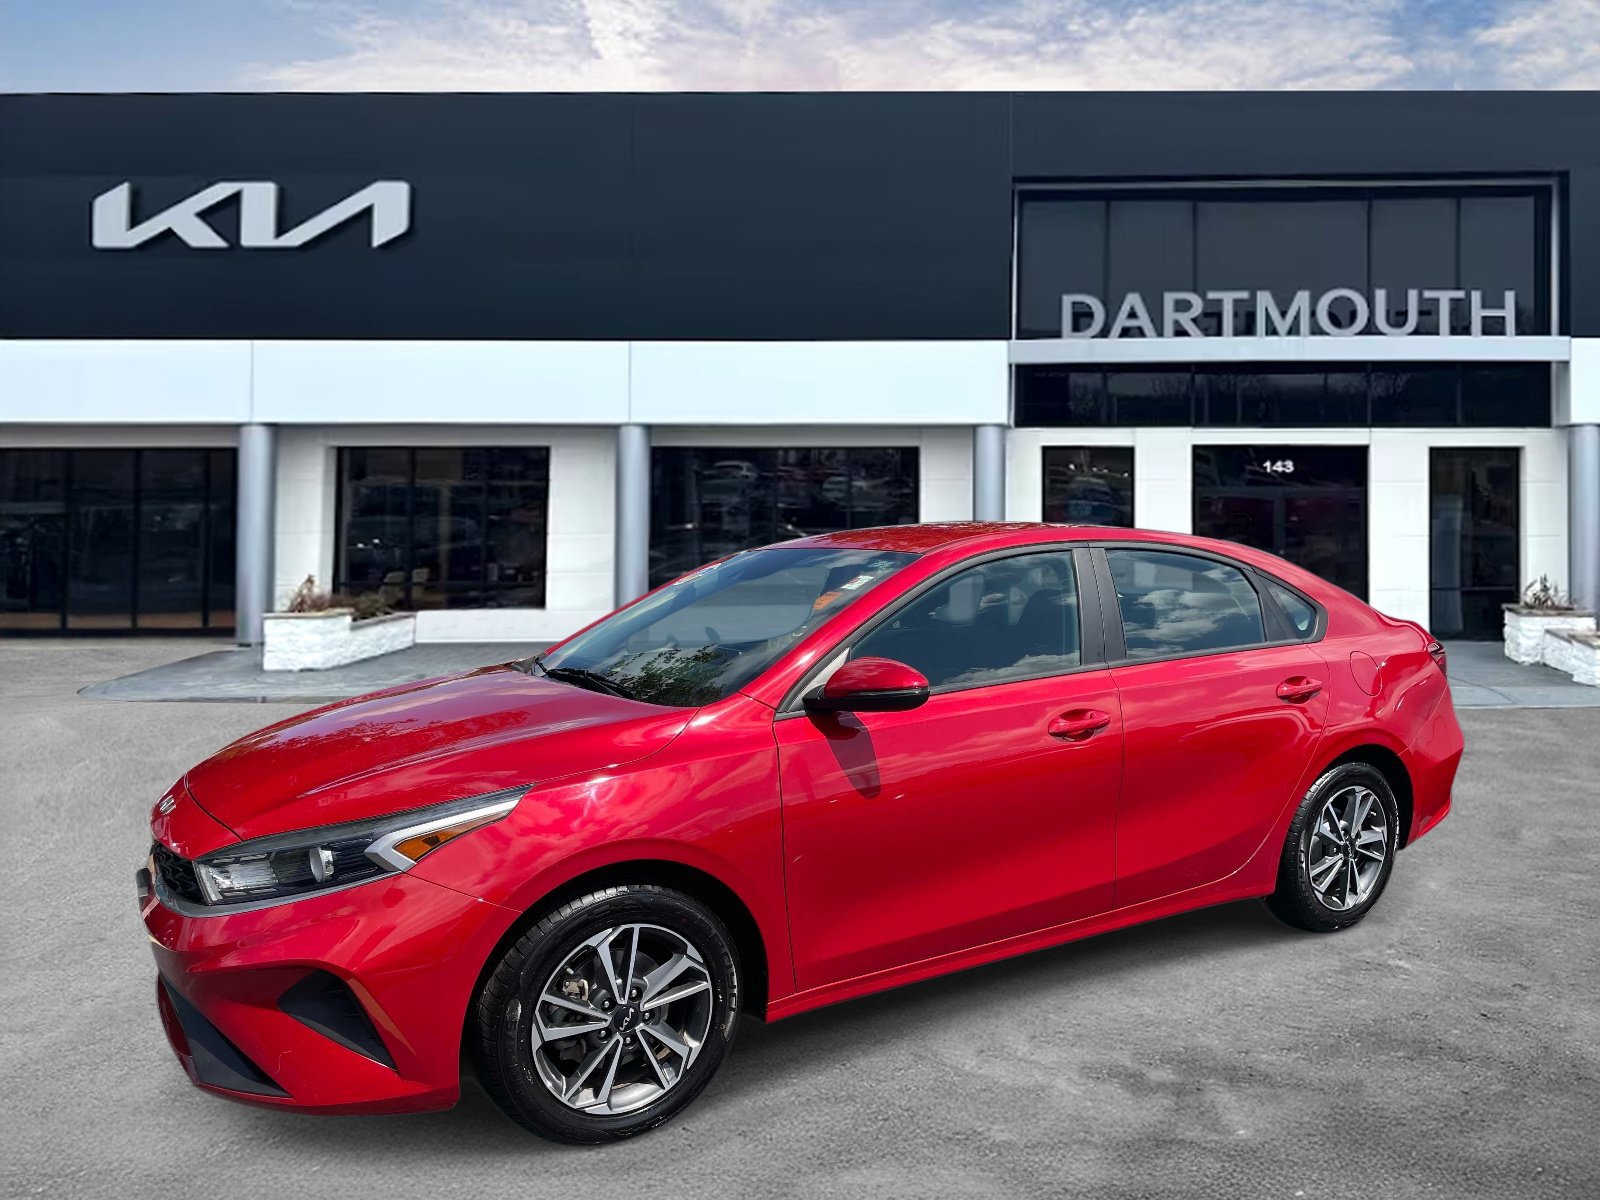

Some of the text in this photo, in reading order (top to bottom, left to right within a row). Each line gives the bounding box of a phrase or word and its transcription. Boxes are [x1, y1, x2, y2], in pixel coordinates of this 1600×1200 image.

[92, 180, 411, 249] KIA
[1061, 288, 1516, 338] DARTMOUTH
[1262, 459, 1295, 473] 143
